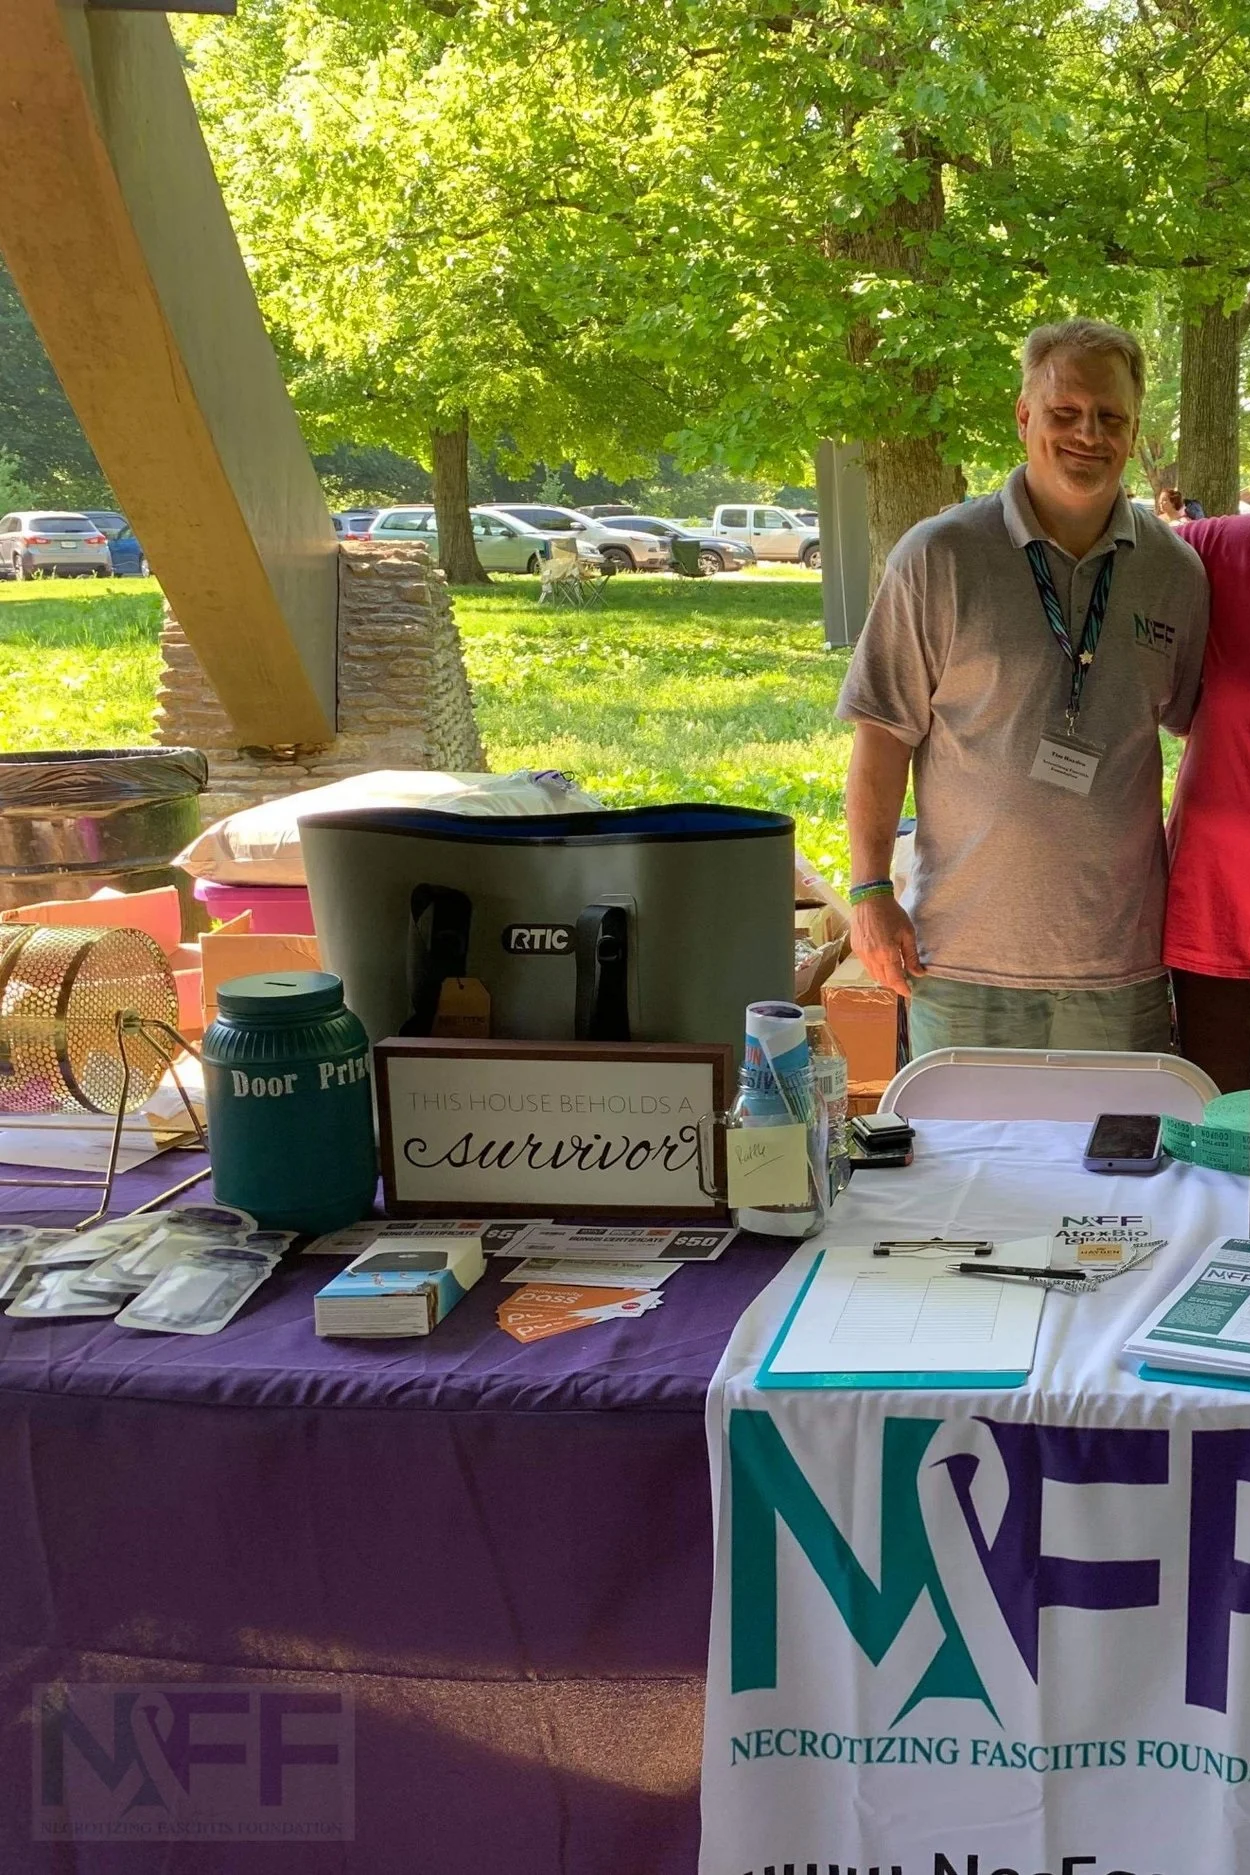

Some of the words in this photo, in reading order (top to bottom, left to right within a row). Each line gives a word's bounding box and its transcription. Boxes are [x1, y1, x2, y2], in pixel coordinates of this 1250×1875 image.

[511, 928, 569, 950] RTIC
[231, 1069, 299, 1098] Door
[408, 1092, 461, 1112] THIS
[470, 1093, 552, 1113] HOUSE
[560, 1094, 671, 1114] BEHOLDS
[678, 1096, 694, 1113] A
[413, 1230, 477, 1238] CERTIFICATE
[604, 1235, 666, 1243] CERTIFICATE
[674, 1235, 720, 1249] $50
[513, 1292, 579, 1305] pass
[731, 1726, 960, 1766] NECROTIZING
[970, 1737, 1127, 1774] FASCIITIS
